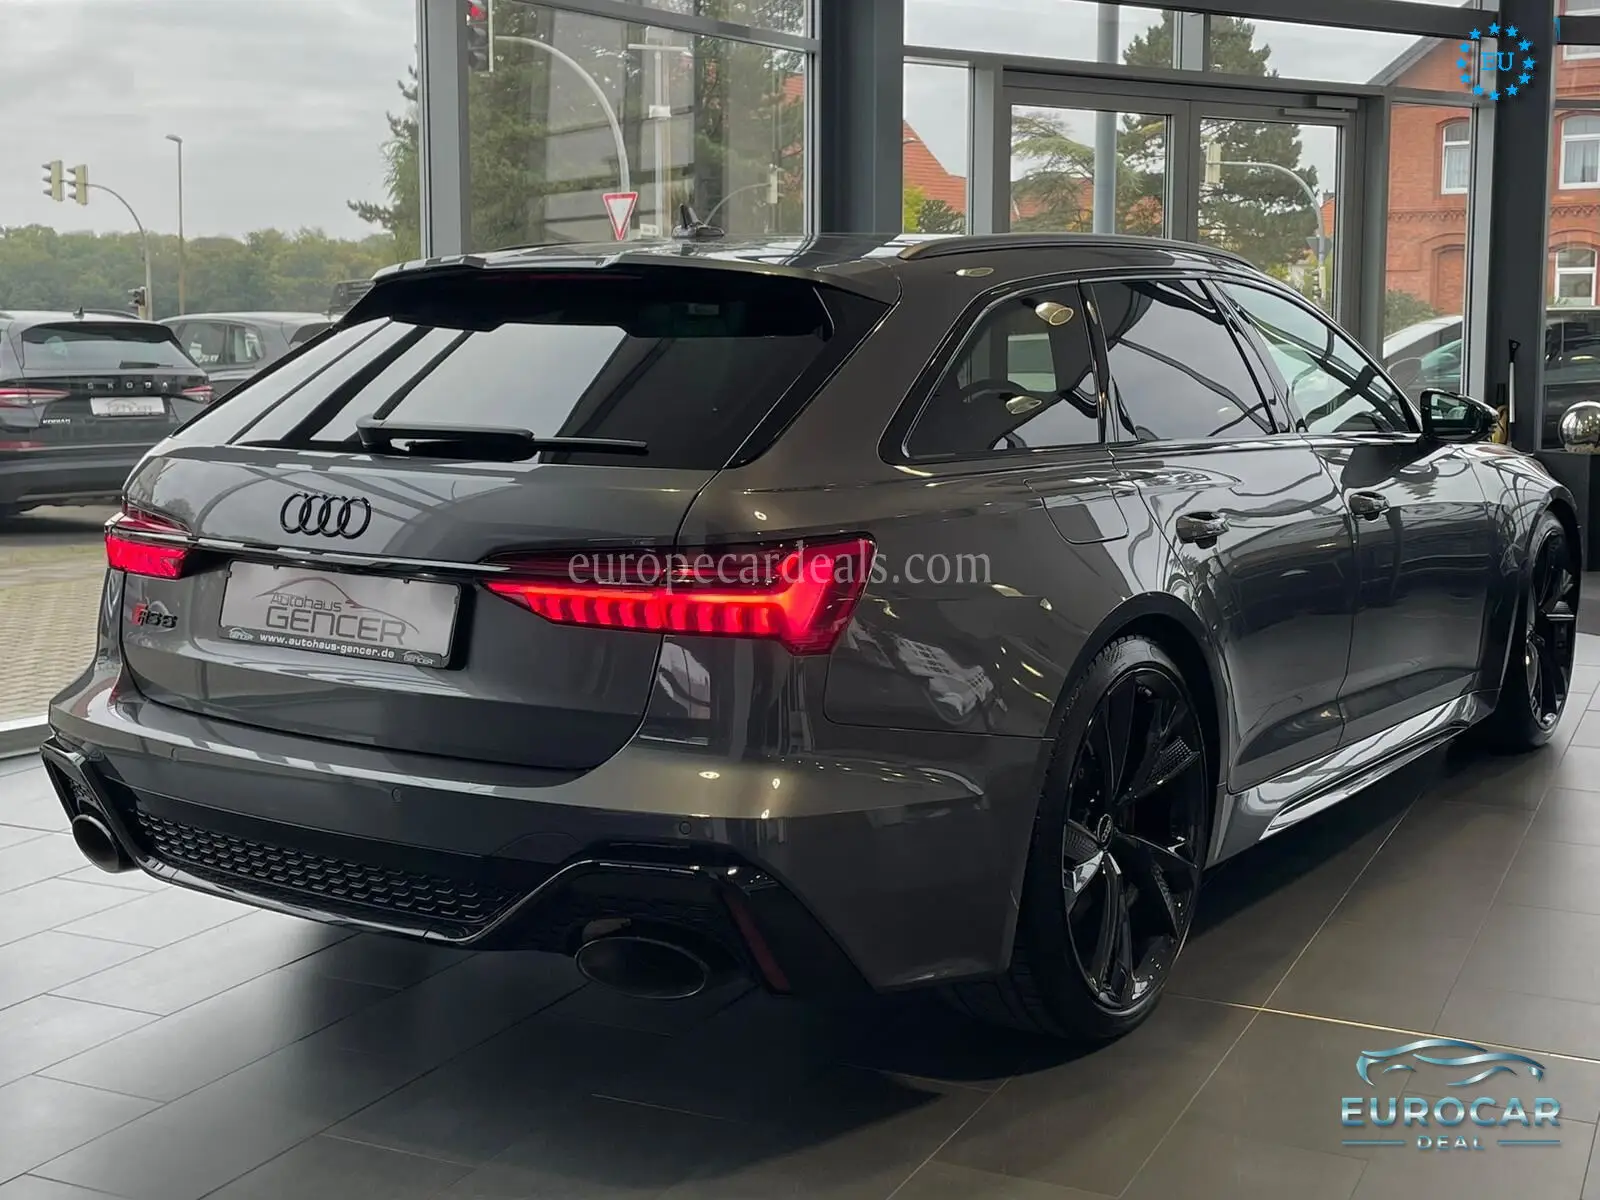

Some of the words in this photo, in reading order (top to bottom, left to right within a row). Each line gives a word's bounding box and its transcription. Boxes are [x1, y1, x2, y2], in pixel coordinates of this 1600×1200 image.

[270, 592, 342, 613] Autohaus
[266, 605, 407, 646] GENCER
[260, 633, 395, 659] www.autohaus-gencer.de
